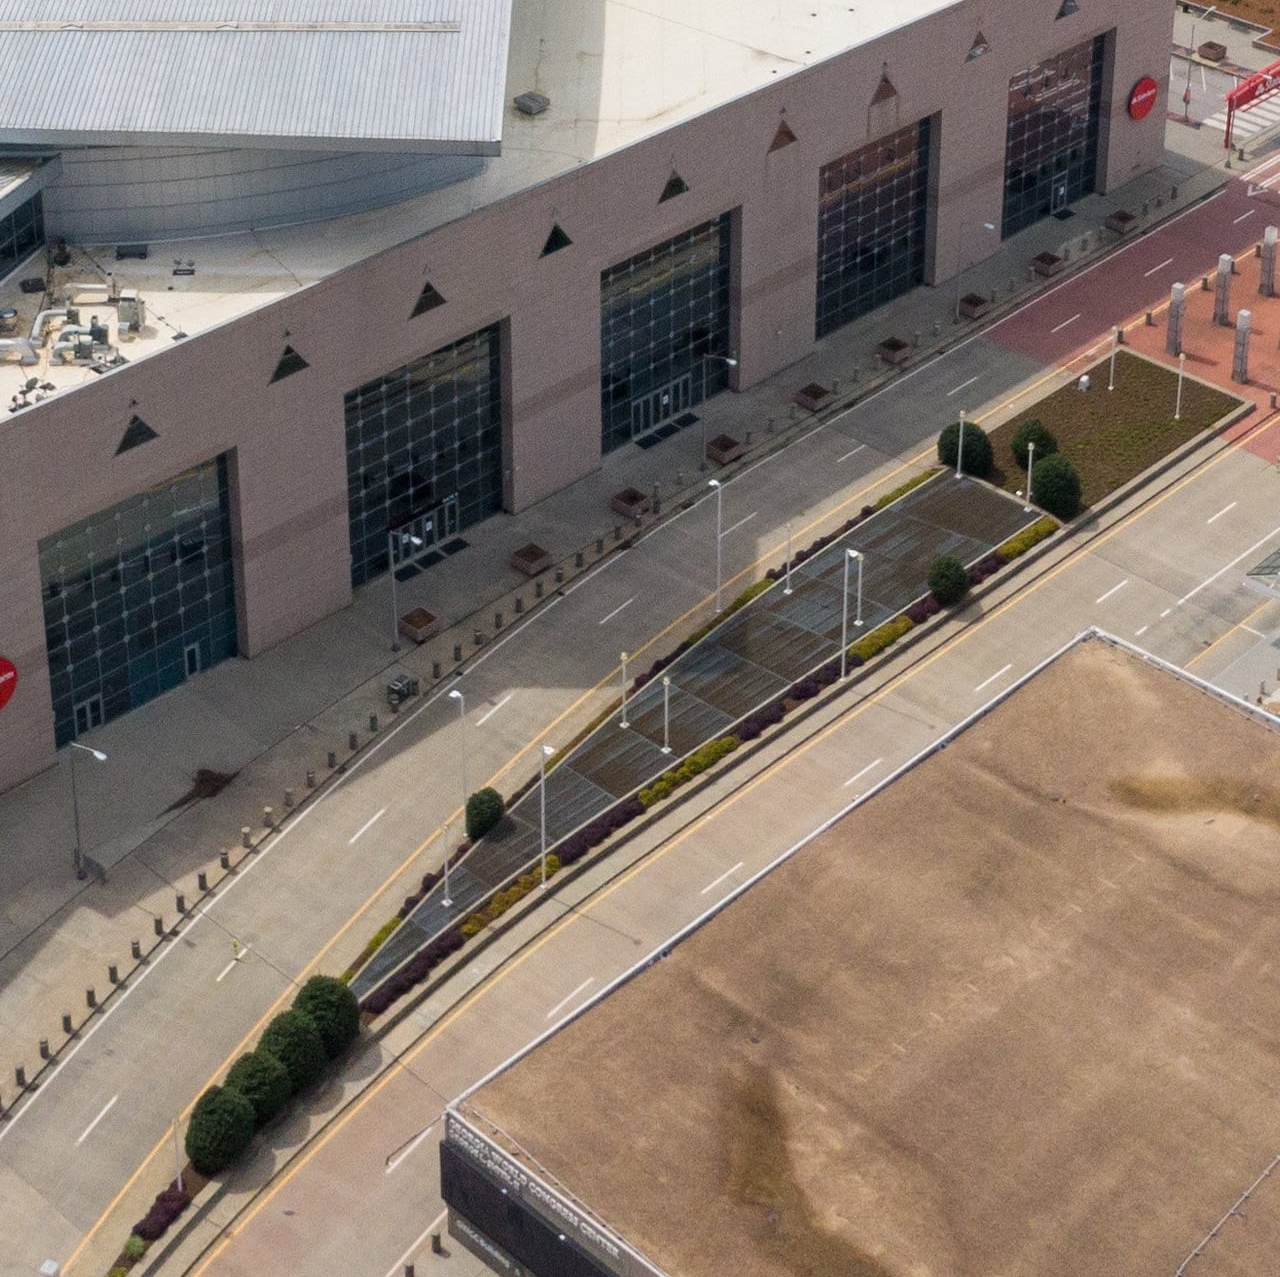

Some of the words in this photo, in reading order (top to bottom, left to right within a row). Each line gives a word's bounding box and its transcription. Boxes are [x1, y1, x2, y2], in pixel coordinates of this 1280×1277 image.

[491, 1151, 527, 1186] WORLD
[528, 1182, 578, 1227] CONGRESS
[580, 1222, 619, 1260] CENTER
